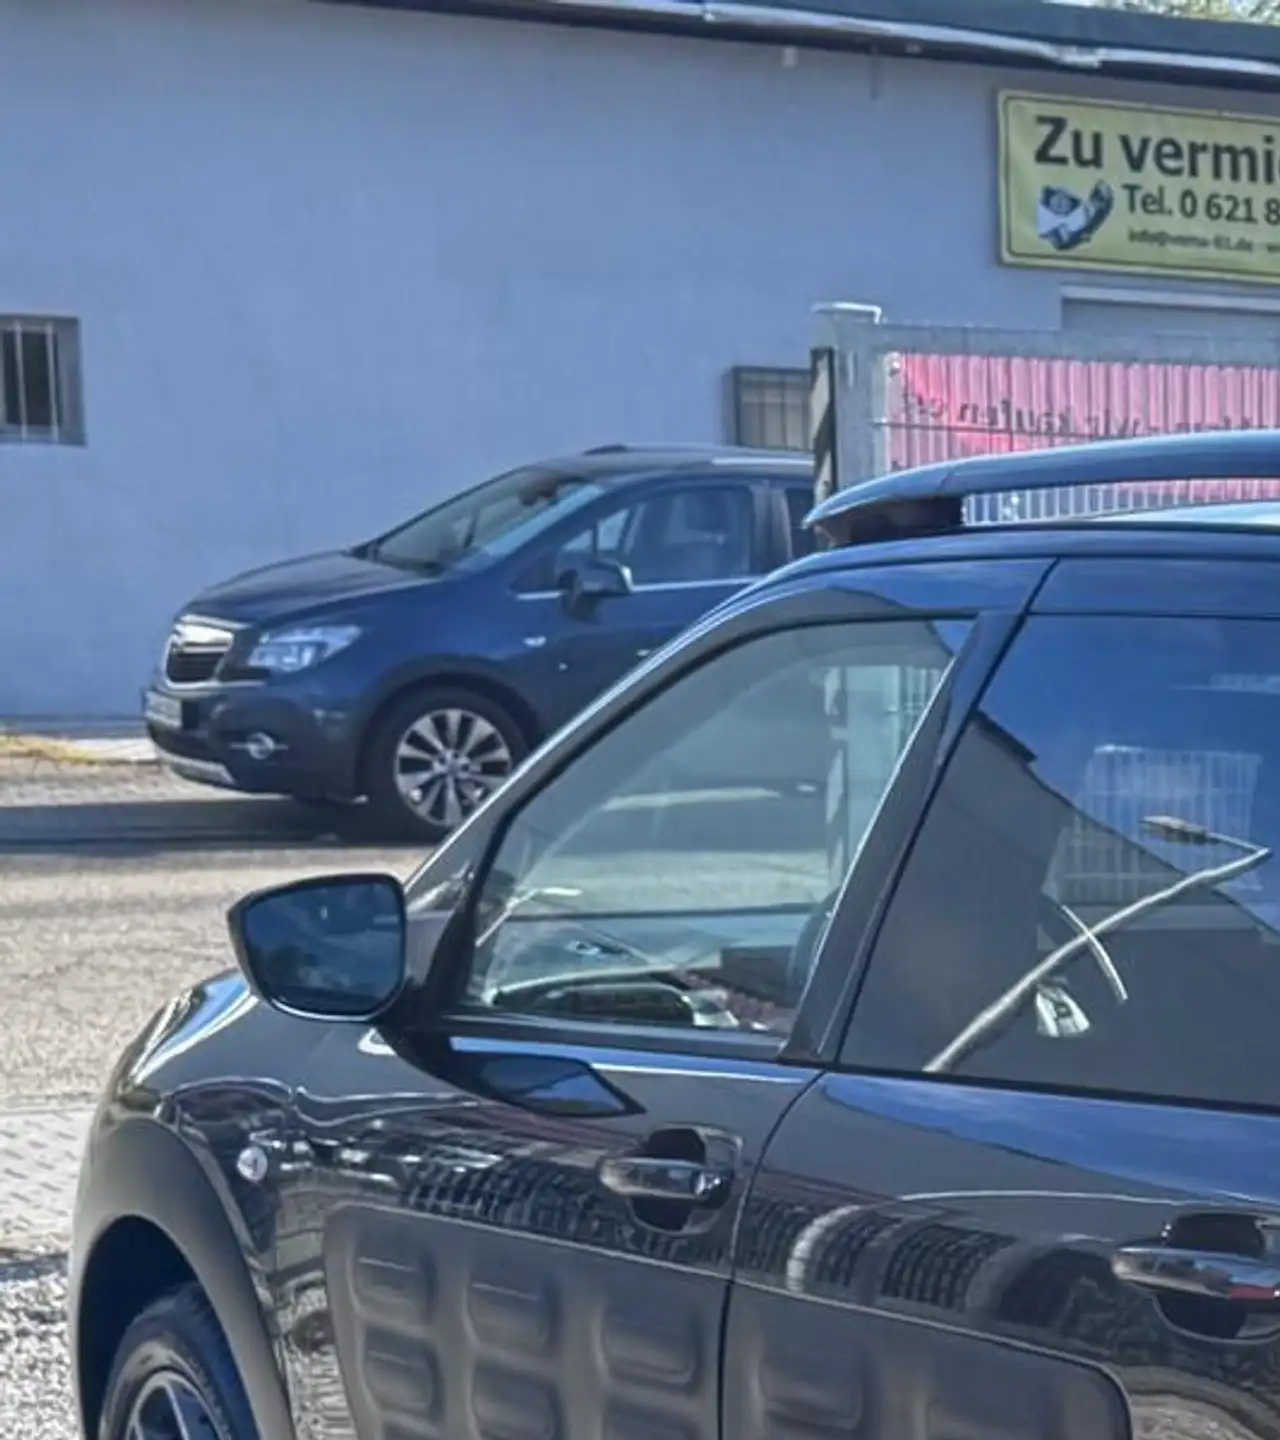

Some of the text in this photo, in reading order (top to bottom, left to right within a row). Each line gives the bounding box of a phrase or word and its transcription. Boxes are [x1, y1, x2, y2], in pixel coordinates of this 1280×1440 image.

[1034, 115, 1104, 169] Zu
[1121, 183, 1172, 217] Tel.
[1204, 193, 1258, 224] 621
